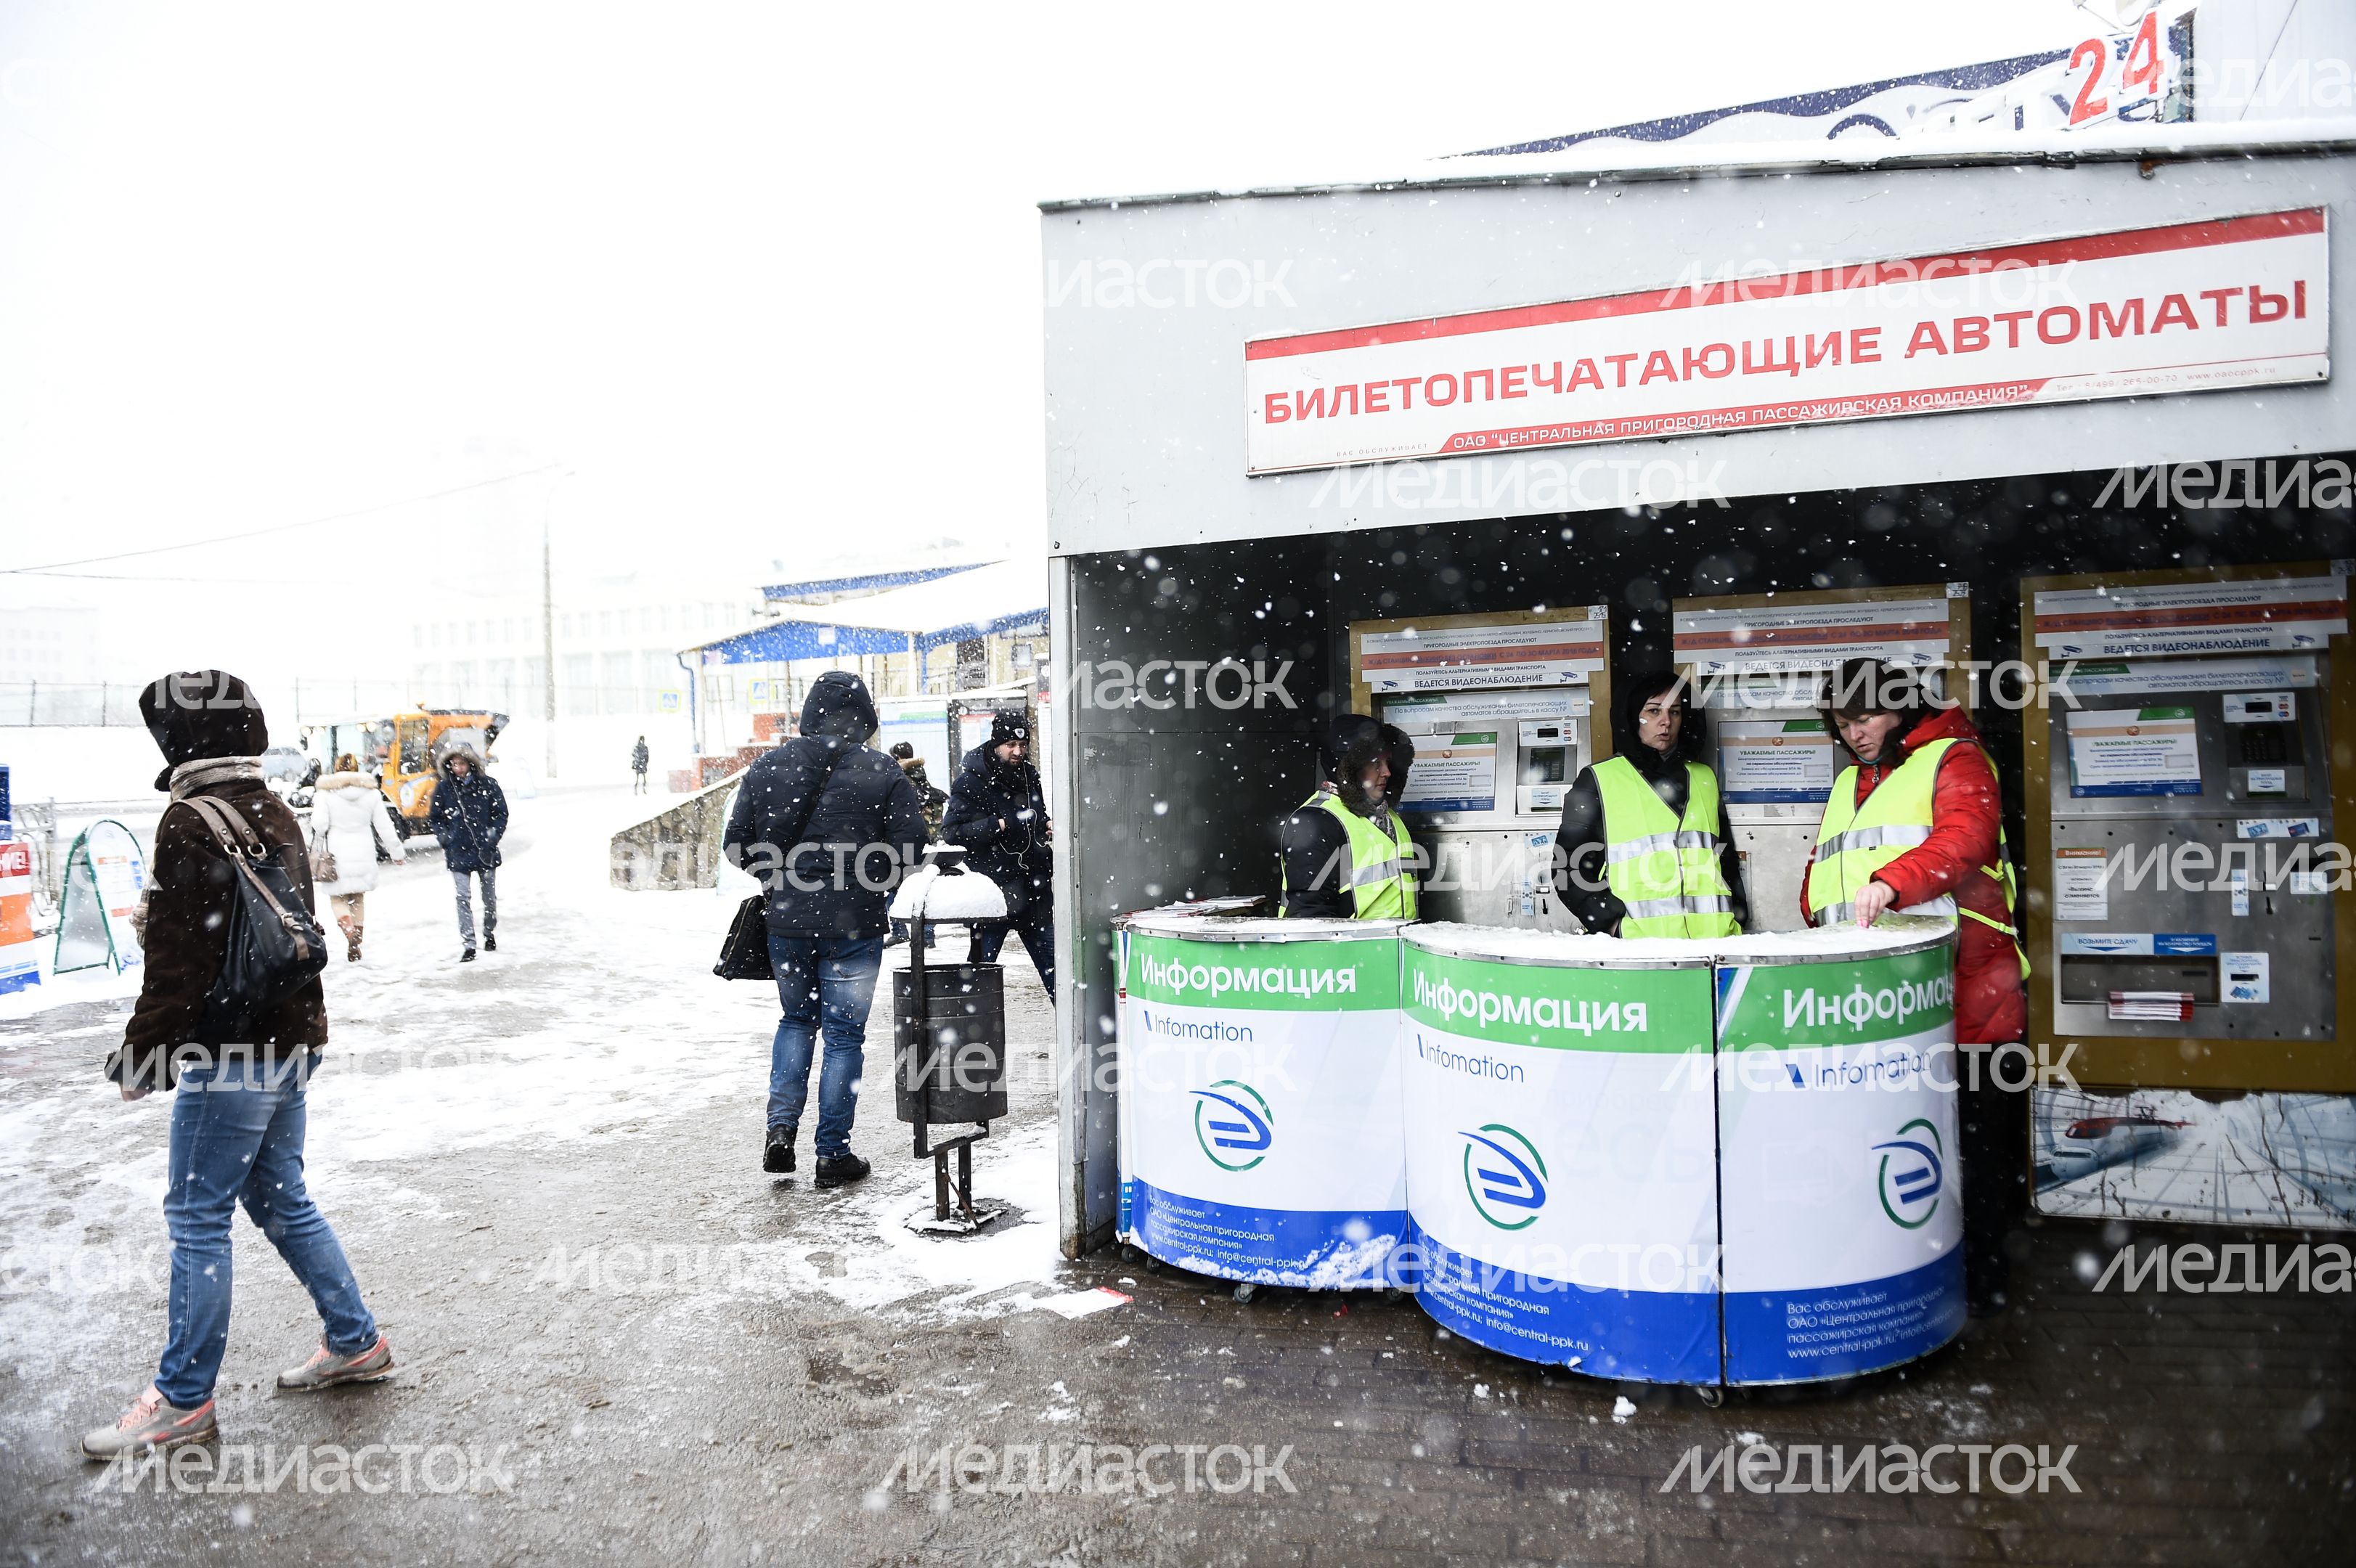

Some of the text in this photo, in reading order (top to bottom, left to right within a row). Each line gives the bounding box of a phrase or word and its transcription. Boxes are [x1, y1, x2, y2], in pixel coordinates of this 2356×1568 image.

[2068, 10, 2164, 126] 24
[1265, 279, 2307, 425] БИЛЕТОПЕЧАТАЮЩИЕ АВТОМАТЫ
[1454, 436, 1486, 449] ОАО
[1621, 410, 1746, 435] ПРИГОРОДНАЯ
[1753, 396, 1901, 422] ПАССАЖИРСКАЯ
[2104, 638, 2270, 655] ВЕДЕТСЯ ВИДЕОНАБЛЮДЕНИЕ
[1414, 674, 1543, 688] ВЕДЕТСЯ ВИДЕОНАБЛЮДЕНИЕ
[1140, 952, 1357, 999] Информация
[1412, 967, 1648, 1037] Информация
[1155, 1014, 1253, 1042] Infomation
[1426, 1040, 1525, 1083] Infomation
[1815, 1050, 1932, 1088] Infomation
[1159, 1200, 1205, 1219] обслуживает
[1213, 1225, 1275, 1242] пригородная
[1466, 1296, 1514, 1320] компания»
[1482, 1288, 1549, 1316] пригородная
[1787, 1292, 1888, 1315] Вас обслуживает
[1787, 1316, 1818, 1329] ОАО
[1820, 1304, 1896, 1327] «Центральная
[1485, 1315, 1589, 1351] info@central-ppk.ru
[1787, 1325, 1877, 1344] пассажирская
